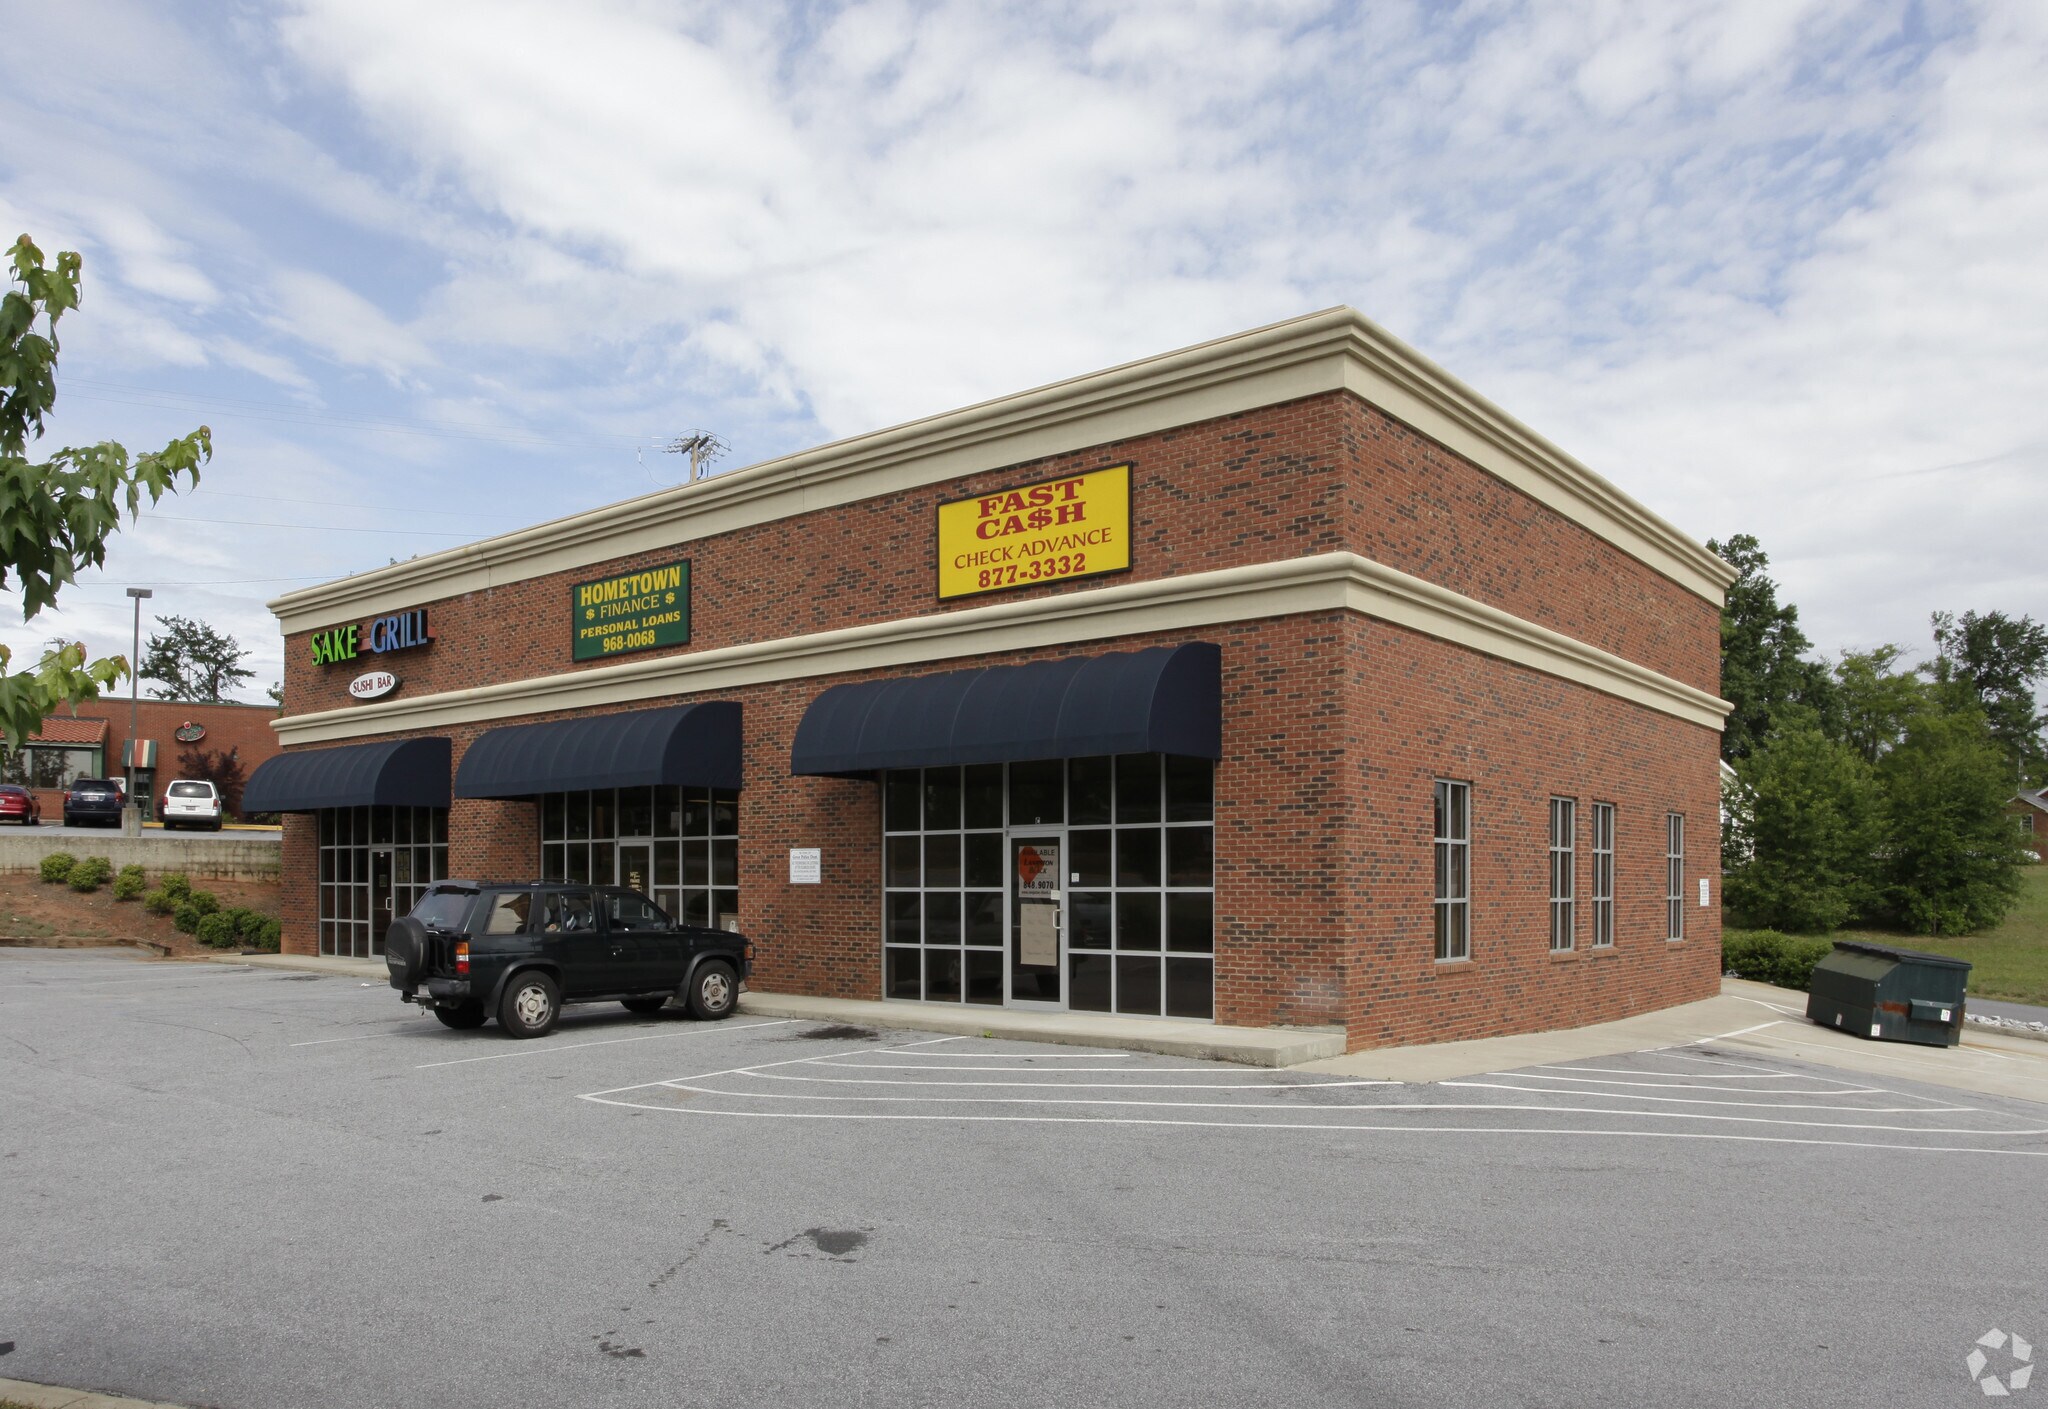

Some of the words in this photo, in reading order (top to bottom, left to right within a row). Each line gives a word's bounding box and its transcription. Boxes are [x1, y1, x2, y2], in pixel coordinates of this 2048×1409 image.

[977, 478, 1084, 519] FAST
[976, 501, 1086, 540] CA$H
[954, 545, 1013, 570] CHECK
[1018, 527, 1112, 559] ADVANCE
[581, 566, 680, 606] HOMETOWN
[978, 552, 1086, 589] 877-3332
[581, 619, 638, 639] PERSONAL
[642, 611, 680, 627] LOANS
[600, 594, 660, 618] FINANCE
[310, 624, 358, 667] SAKE
[370, 608, 427, 654] GRILL
[603, 630, 655, 652] 968-0068
[353, 679, 373, 693] SUSHI
[378, 675, 391, 689] BAR
